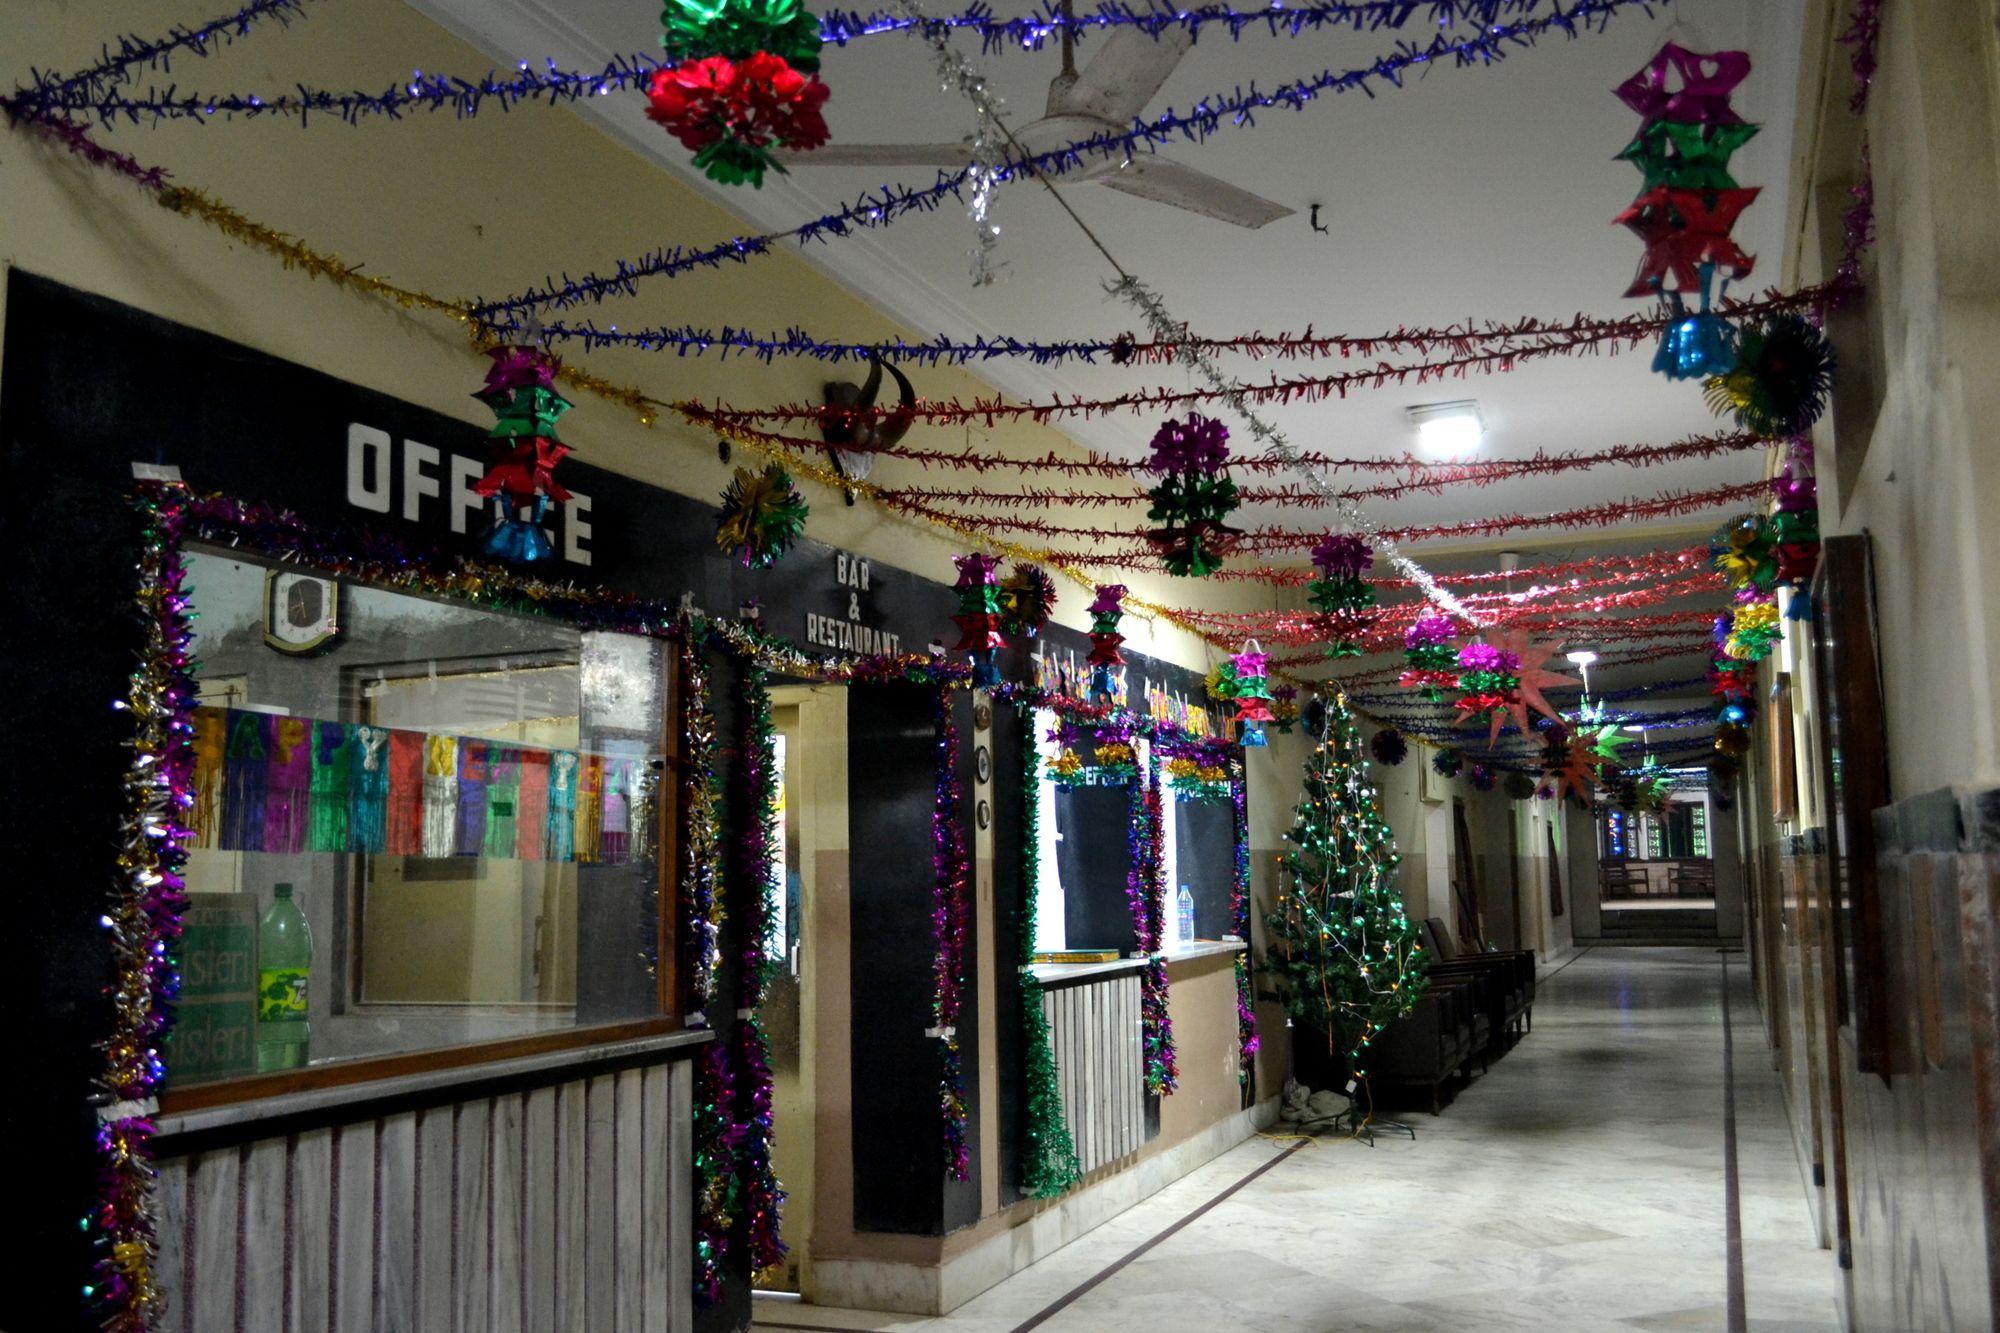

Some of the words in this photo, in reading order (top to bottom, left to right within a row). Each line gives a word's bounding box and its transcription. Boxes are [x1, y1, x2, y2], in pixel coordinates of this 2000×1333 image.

[347, 422, 592, 567] OFFE
[837, 554, 870, 591] BAR
[848, 592, 860, 620] &
